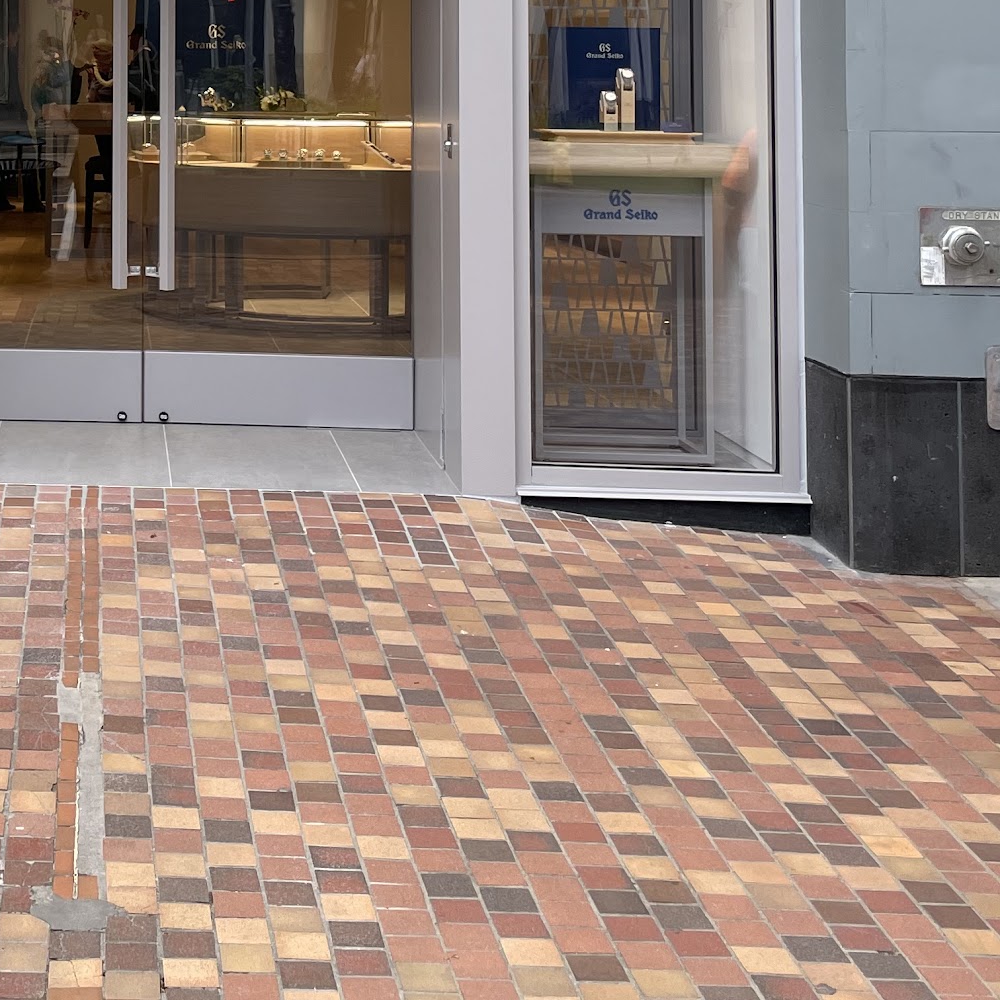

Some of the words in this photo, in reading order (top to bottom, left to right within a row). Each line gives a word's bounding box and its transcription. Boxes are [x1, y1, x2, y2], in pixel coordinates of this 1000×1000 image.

[185, 40, 218, 49] Grand
[608, 189, 632, 207] GS
[583, 208, 622, 220] Grand
[625, 208, 658, 220] Seiko
[948, 211, 968, 220] DRY
